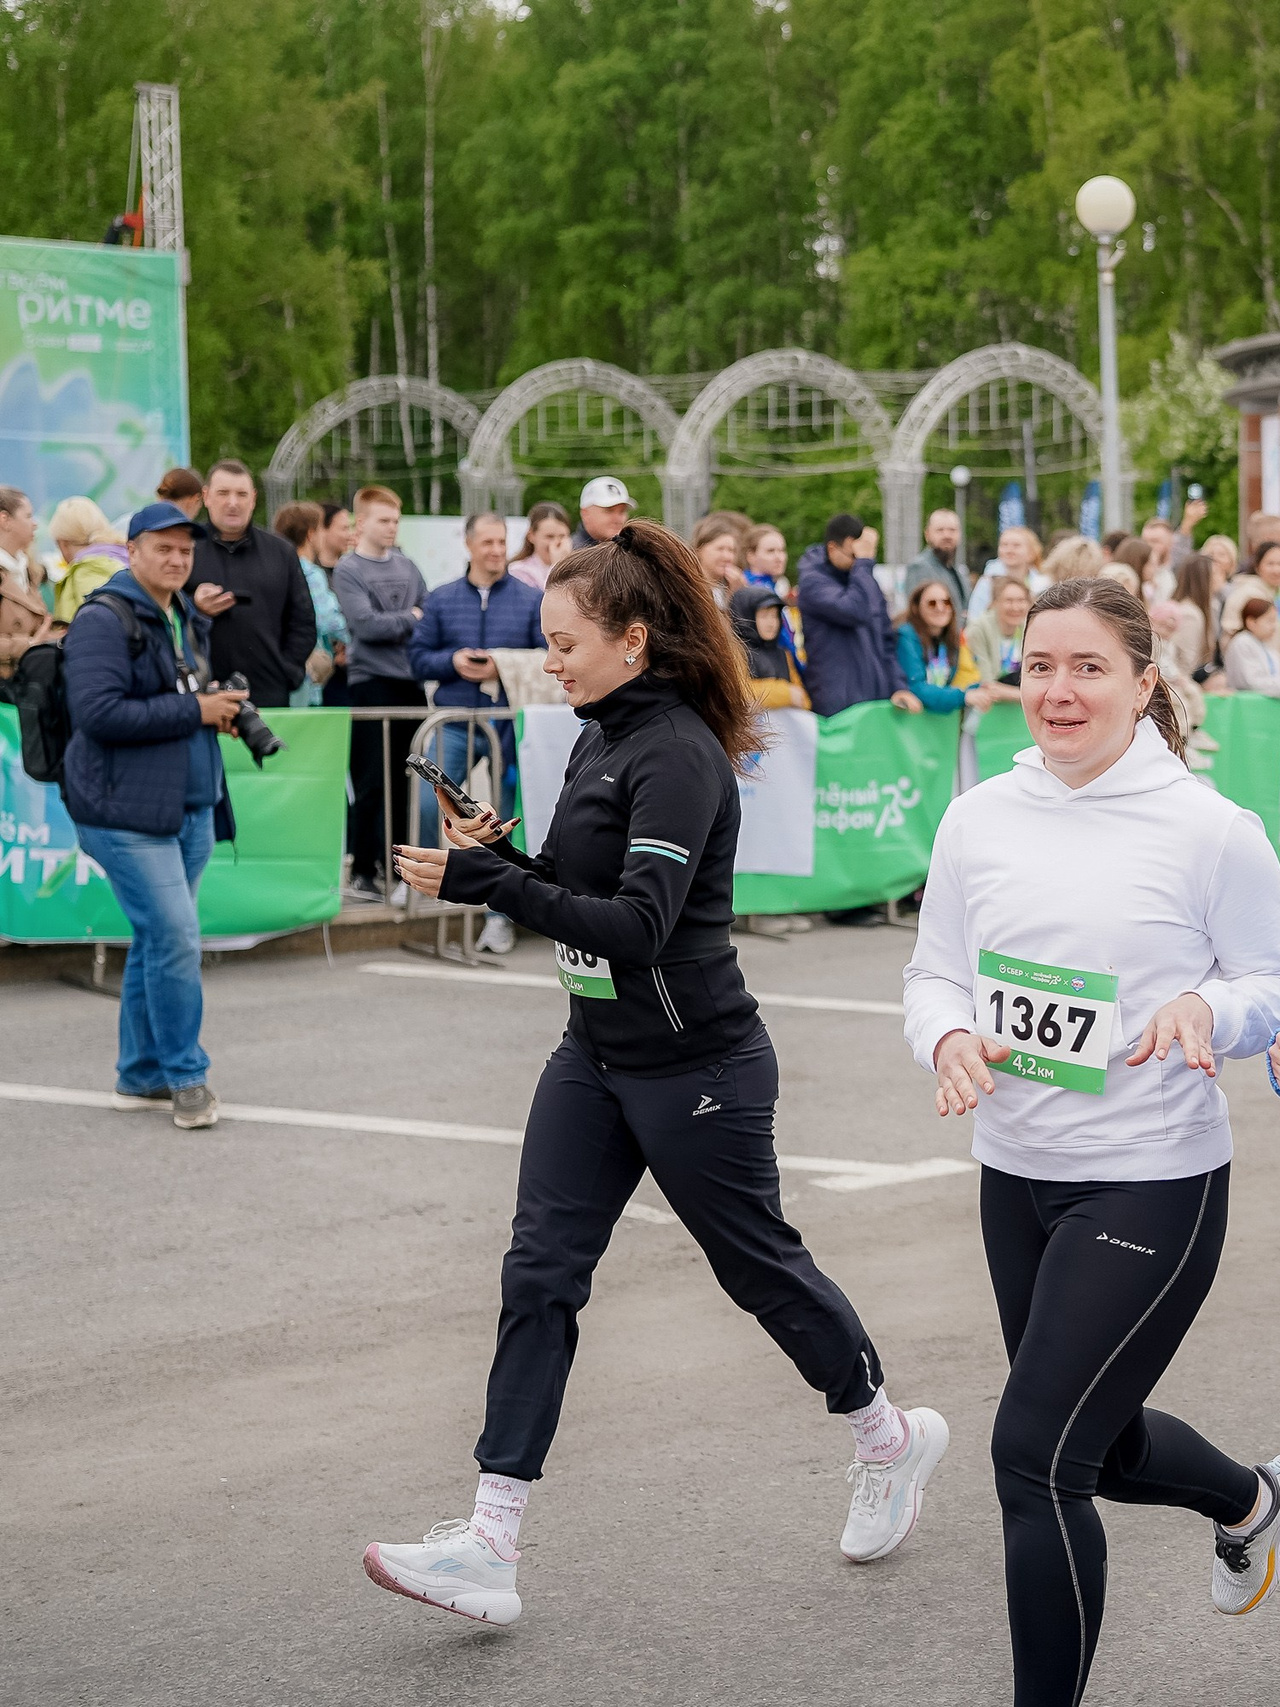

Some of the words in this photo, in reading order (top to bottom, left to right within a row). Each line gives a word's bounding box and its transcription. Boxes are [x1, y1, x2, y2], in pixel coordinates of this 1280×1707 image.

[17, 291, 152, 332] ритме
[816, 780, 878, 807] лёный
[817, 806, 875, 834] афон
[989, 989, 1097, 1053] 1367
[692, 1103, 722, 1116] DEMIX
[1109, 1238, 1156, 1256] DEMIX
[870, 1436, 898, 1453] FILA
[481, 1479, 512, 1492] FILA
[511, 1496, 527, 1507] FIL
[476, 1506, 503, 1523] FILA
